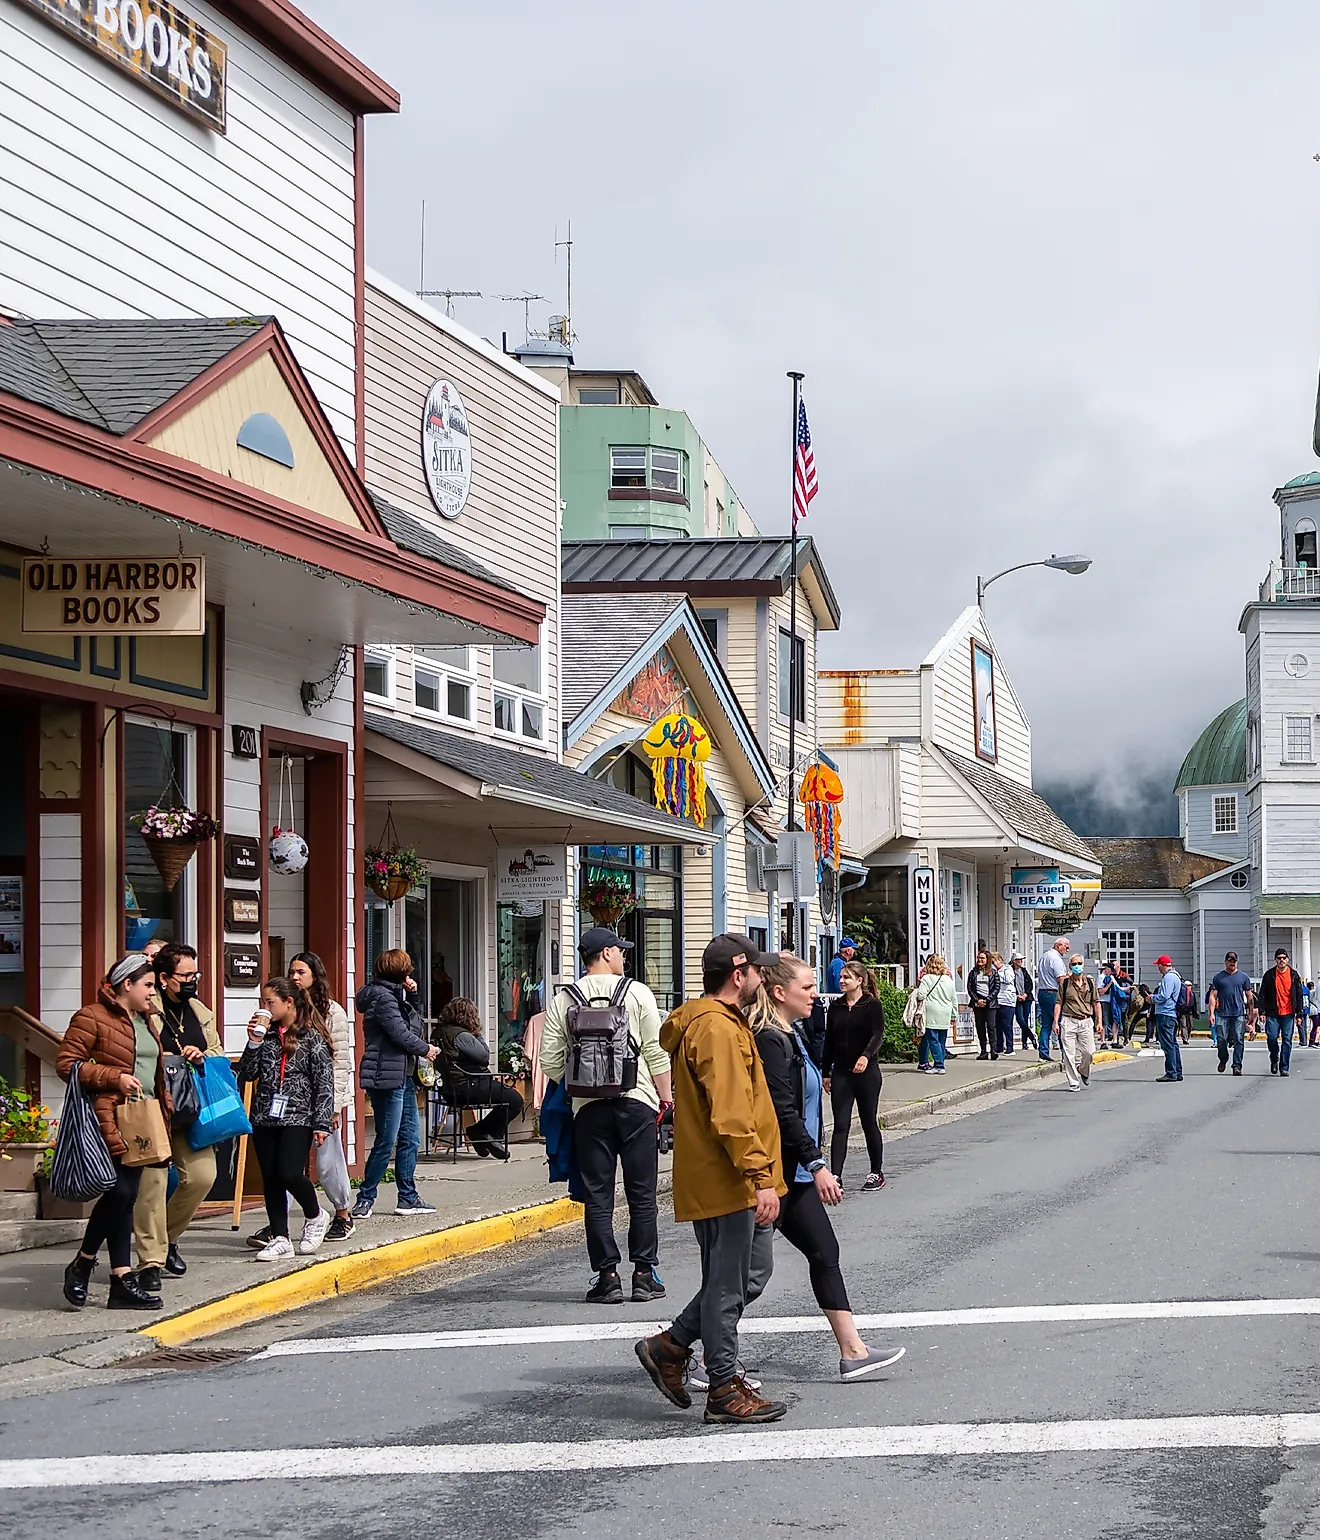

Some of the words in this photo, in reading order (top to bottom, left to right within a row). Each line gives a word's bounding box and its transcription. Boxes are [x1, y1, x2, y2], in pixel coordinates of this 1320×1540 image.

[95, 0, 212, 99] BOOKS
[432, 440, 463, 472] SITKA
[28, 563, 77, 591] OLD
[85, 562, 197, 591] HARBOR
[63, 596, 161, 624] BOOKS
[239, 729, 256, 753] 201
[1008, 886, 1034, 894] Blue
[1037, 885, 1065, 895] Eyed
[1019, 896, 1055, 905] BEAR
